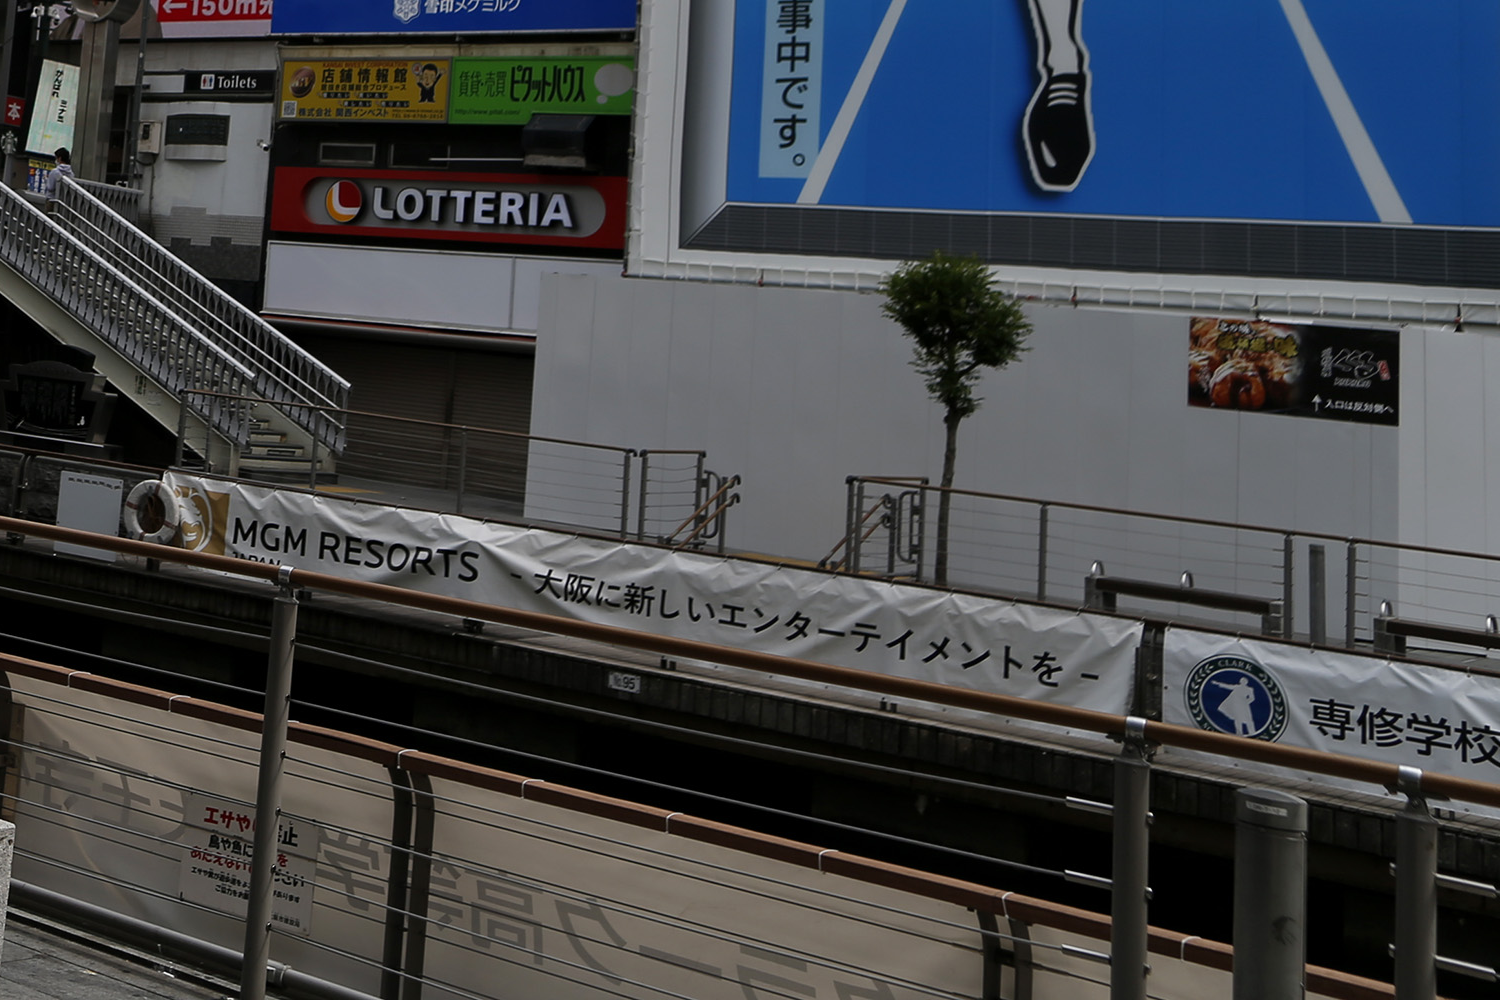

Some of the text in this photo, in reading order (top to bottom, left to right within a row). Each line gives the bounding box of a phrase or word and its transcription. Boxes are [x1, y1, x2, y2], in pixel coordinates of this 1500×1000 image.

[218, 75, 257, 89] Toilets
[321, 67, 408, 84] 店舗情報館
[510, 64, 586, 103] ピタットハウス
[372, 183, 573, 230] LOTTERIA
[231, 517, 480, 583] MGM RESORTS
[1218, 660, 1253, 671] CLARK
[1309, 697, 1500, 769] 専修学校
